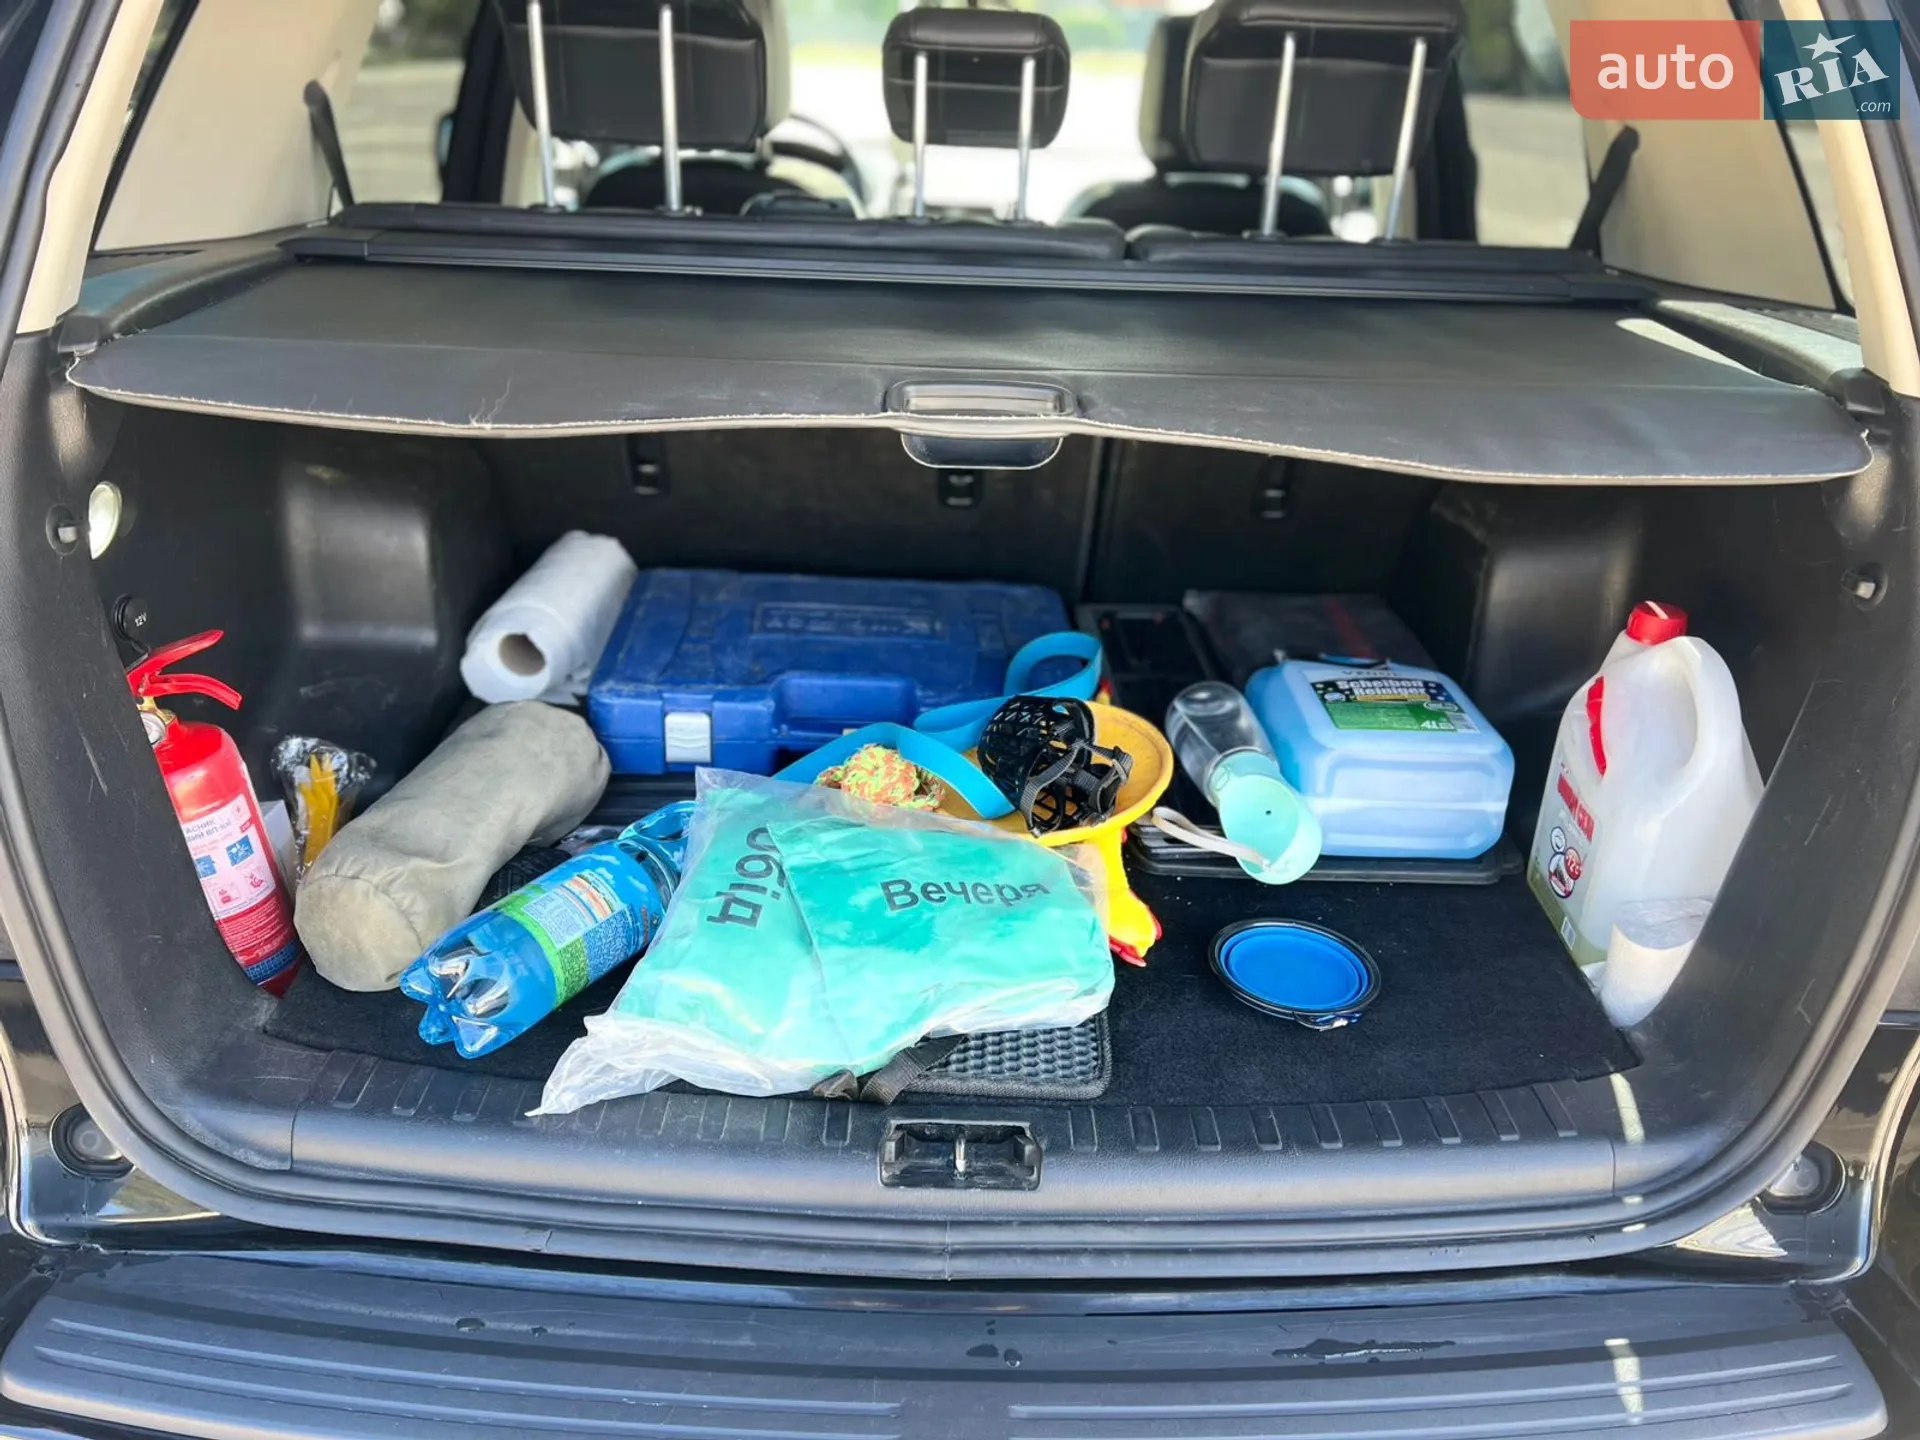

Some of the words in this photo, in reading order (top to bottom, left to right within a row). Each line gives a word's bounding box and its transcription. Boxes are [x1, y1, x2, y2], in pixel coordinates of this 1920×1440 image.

[135, 612, 147, 627] 12V
[1336, 680, 1424, 689] Scheiben
[880, 879, 1051, 912] Вечеря
